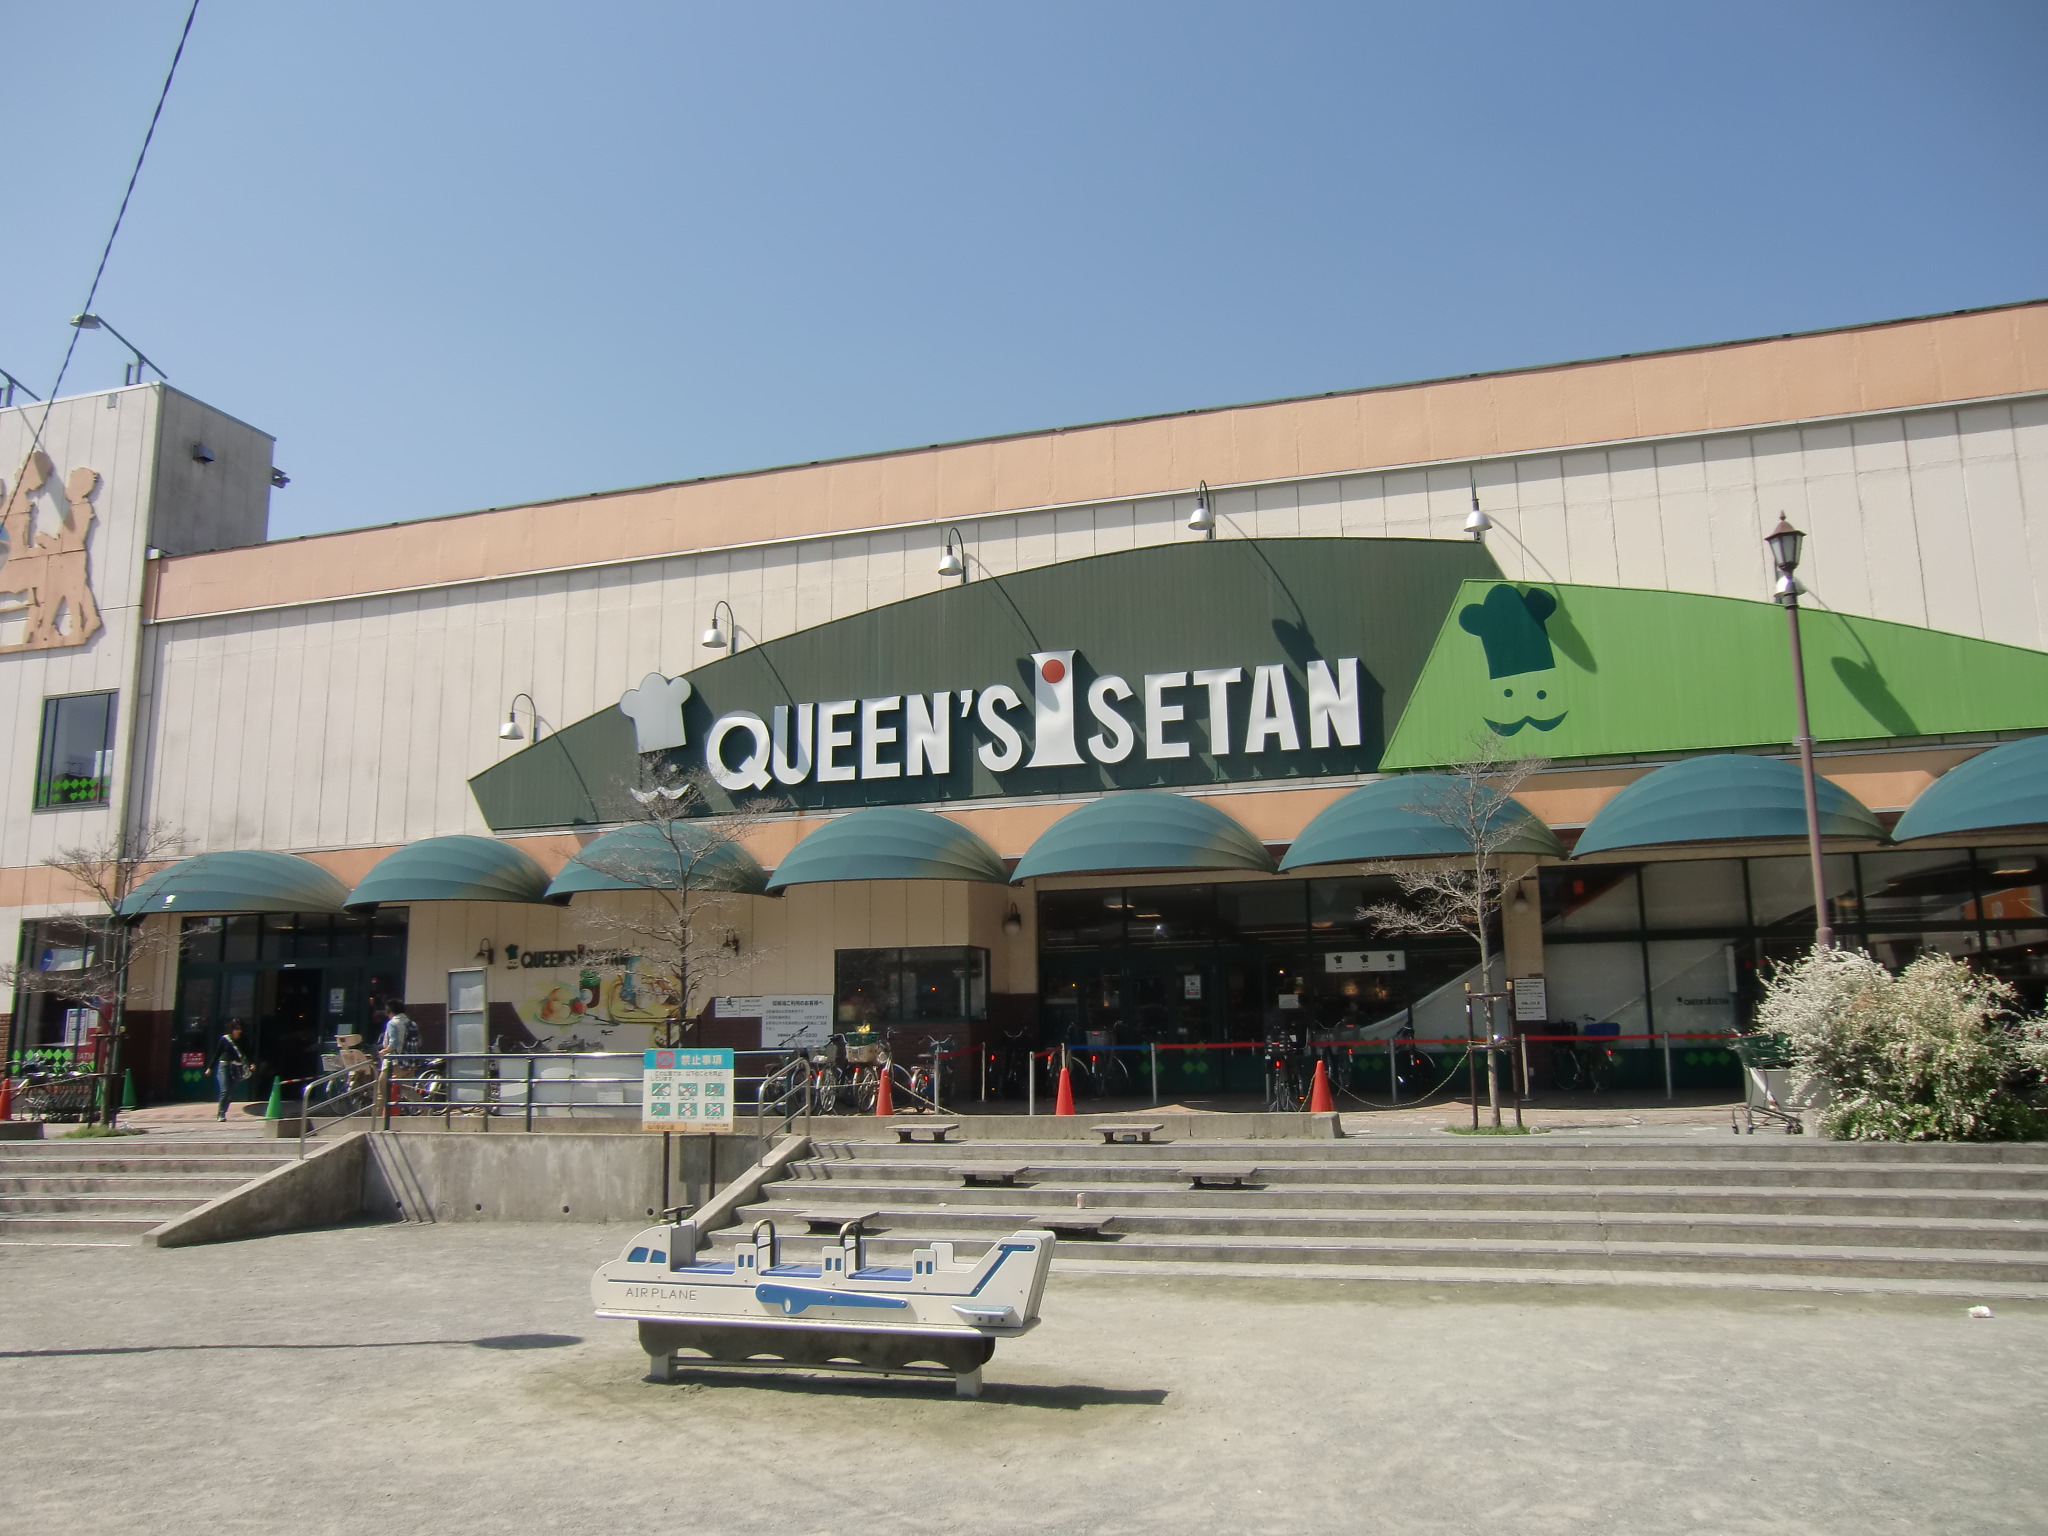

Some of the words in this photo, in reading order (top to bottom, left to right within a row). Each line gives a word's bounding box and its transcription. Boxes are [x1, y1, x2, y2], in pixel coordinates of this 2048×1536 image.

[706, 684, 1023, 791] QUEEN'S
[1023, 649, 1361, 769] ISETAN
[681, 1055, 722, 1065] 禁止事項
[625, 1288, 698, 1301] AIRPLANE
